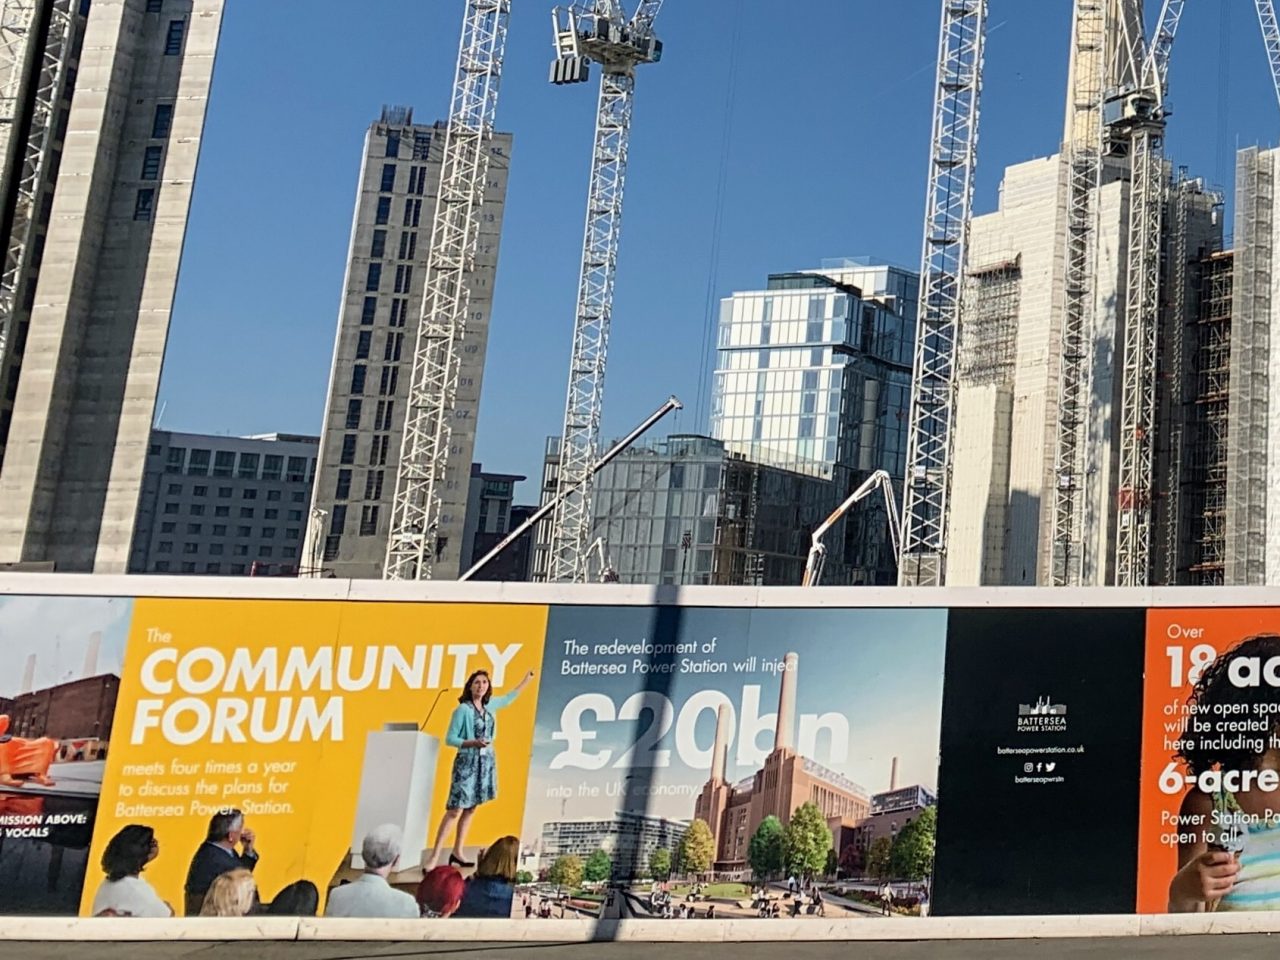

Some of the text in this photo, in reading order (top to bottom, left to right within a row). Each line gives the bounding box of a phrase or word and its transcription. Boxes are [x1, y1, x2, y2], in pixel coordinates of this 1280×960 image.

[147, 628, 172, 644] The
[1167, 624, 1205, 639] Over
[564, 637, 717, 658] The redevelopment of
[140, 643, 524, 695] COMMUNITY
[561, 656, 799, 677] Battersea Power Station will inject
[1166, 643, 1217, 688] 18
[1164, 699, 1180, 715] of
[1182, 703, 1210, 715] new
[1214, 702, 1249, 719] open
[131, 696, 344, 746] FORUM
[549, 684, 851, 771] £20bn
[1017, 716, 1067, 726] BATTERSEA
[1164, 715, 1269, 733] will be created
[997, 744, 1085, 756] batterseapowerstation.co.uk
[1163, 736, 1195, 751] here
[1200, 734, 1265, 754] including
[122, 757, 297, 777] meets four times a year
[118, 776, 289, 799] to discuss the plans for
[1158, 761, 1280, 795] 6-acre
[546, 783, 573, 799] into
[578, 781, 600, 798] the
[605, 781, 627, 798] UK
[114, 799, 294, 818] Battersea Power Station.
[1161, 810, 1206, 826] Power
[1210, 809, 1259, 825] Station
[0, 814, 87, 825] ISSION ABOVE:
[6, 827, 49, 838] VOCALS
[1160, 831, 1197, 848] open
[1202, 829, 1216, 843] to
